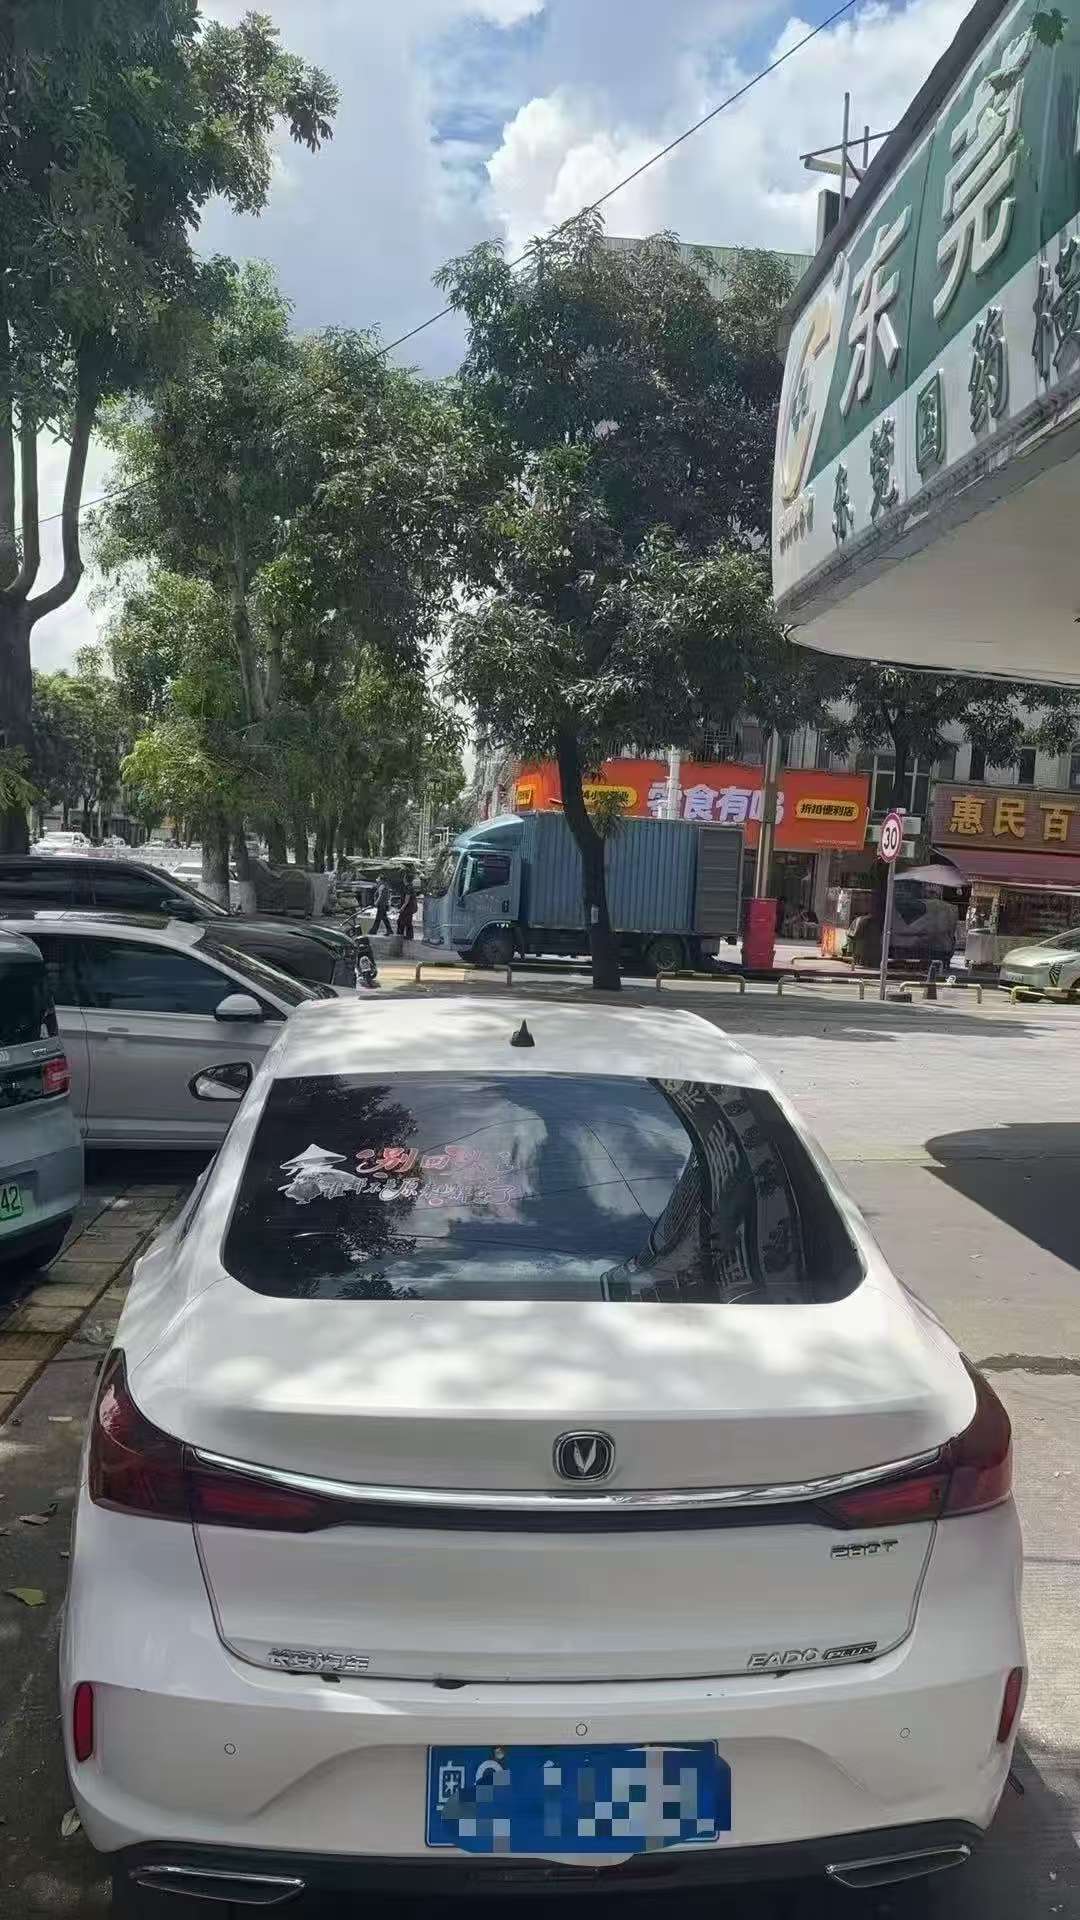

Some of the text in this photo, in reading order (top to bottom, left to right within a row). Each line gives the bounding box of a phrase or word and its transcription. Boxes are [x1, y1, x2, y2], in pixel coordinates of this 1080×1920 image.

[800, 803, 855, 817] 折扣便利店
[949, 795, 1073, 841] 惠民百
[883, 827, 897, 850] 30
[747, 1648, 821, 1668] EADO
